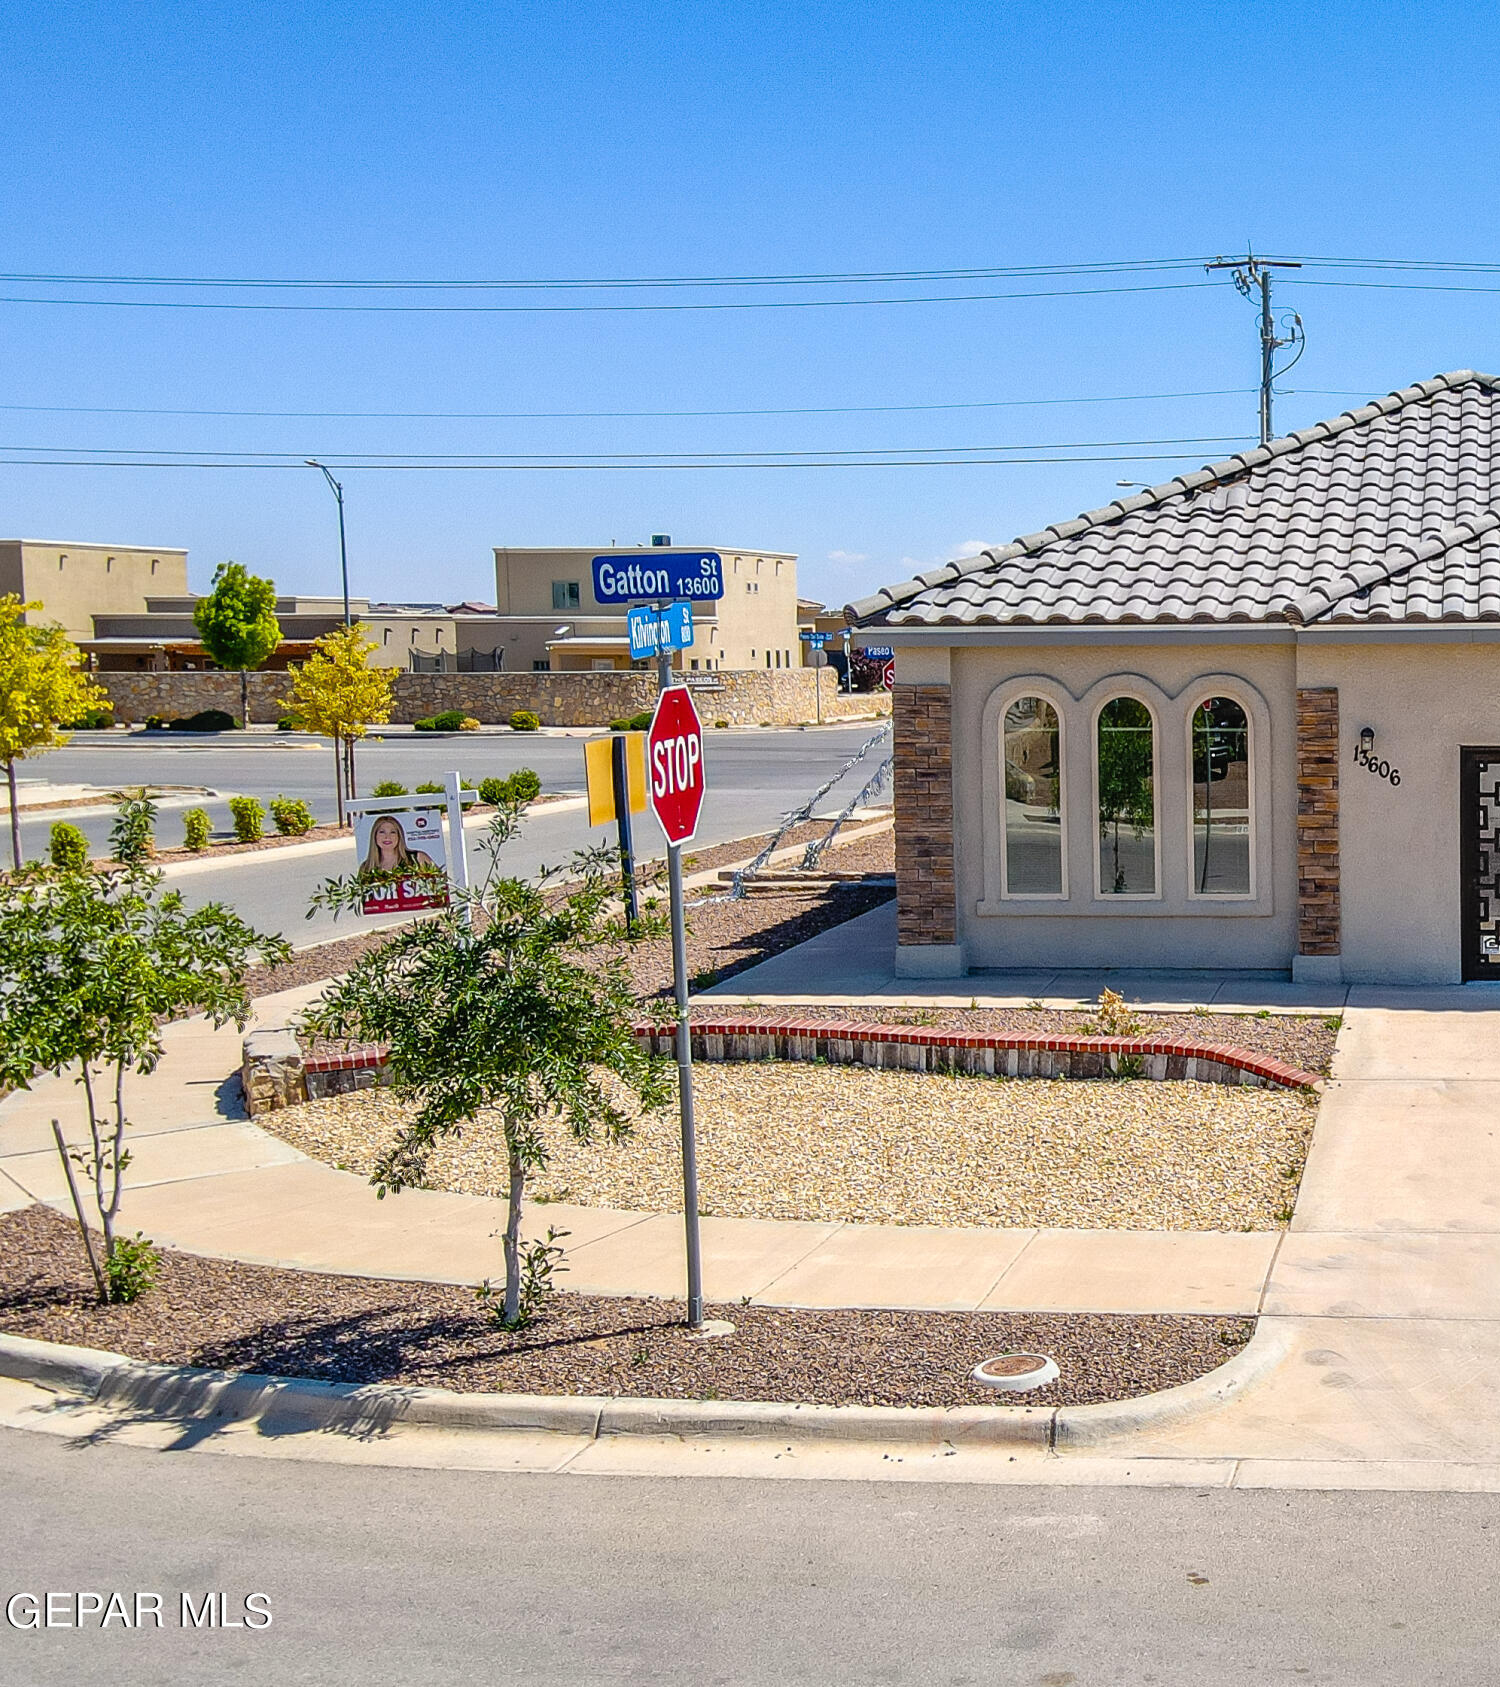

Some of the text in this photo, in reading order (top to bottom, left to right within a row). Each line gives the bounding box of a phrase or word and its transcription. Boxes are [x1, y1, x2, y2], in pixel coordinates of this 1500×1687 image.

[599, 558, 718, 595] Gatton St
[676, 576, 719, 595] 13600
[868, 647, 889, 656] Paseo
[653, 733, 699, 798] STOP
[1353, 744, 1401, 786] 13606
